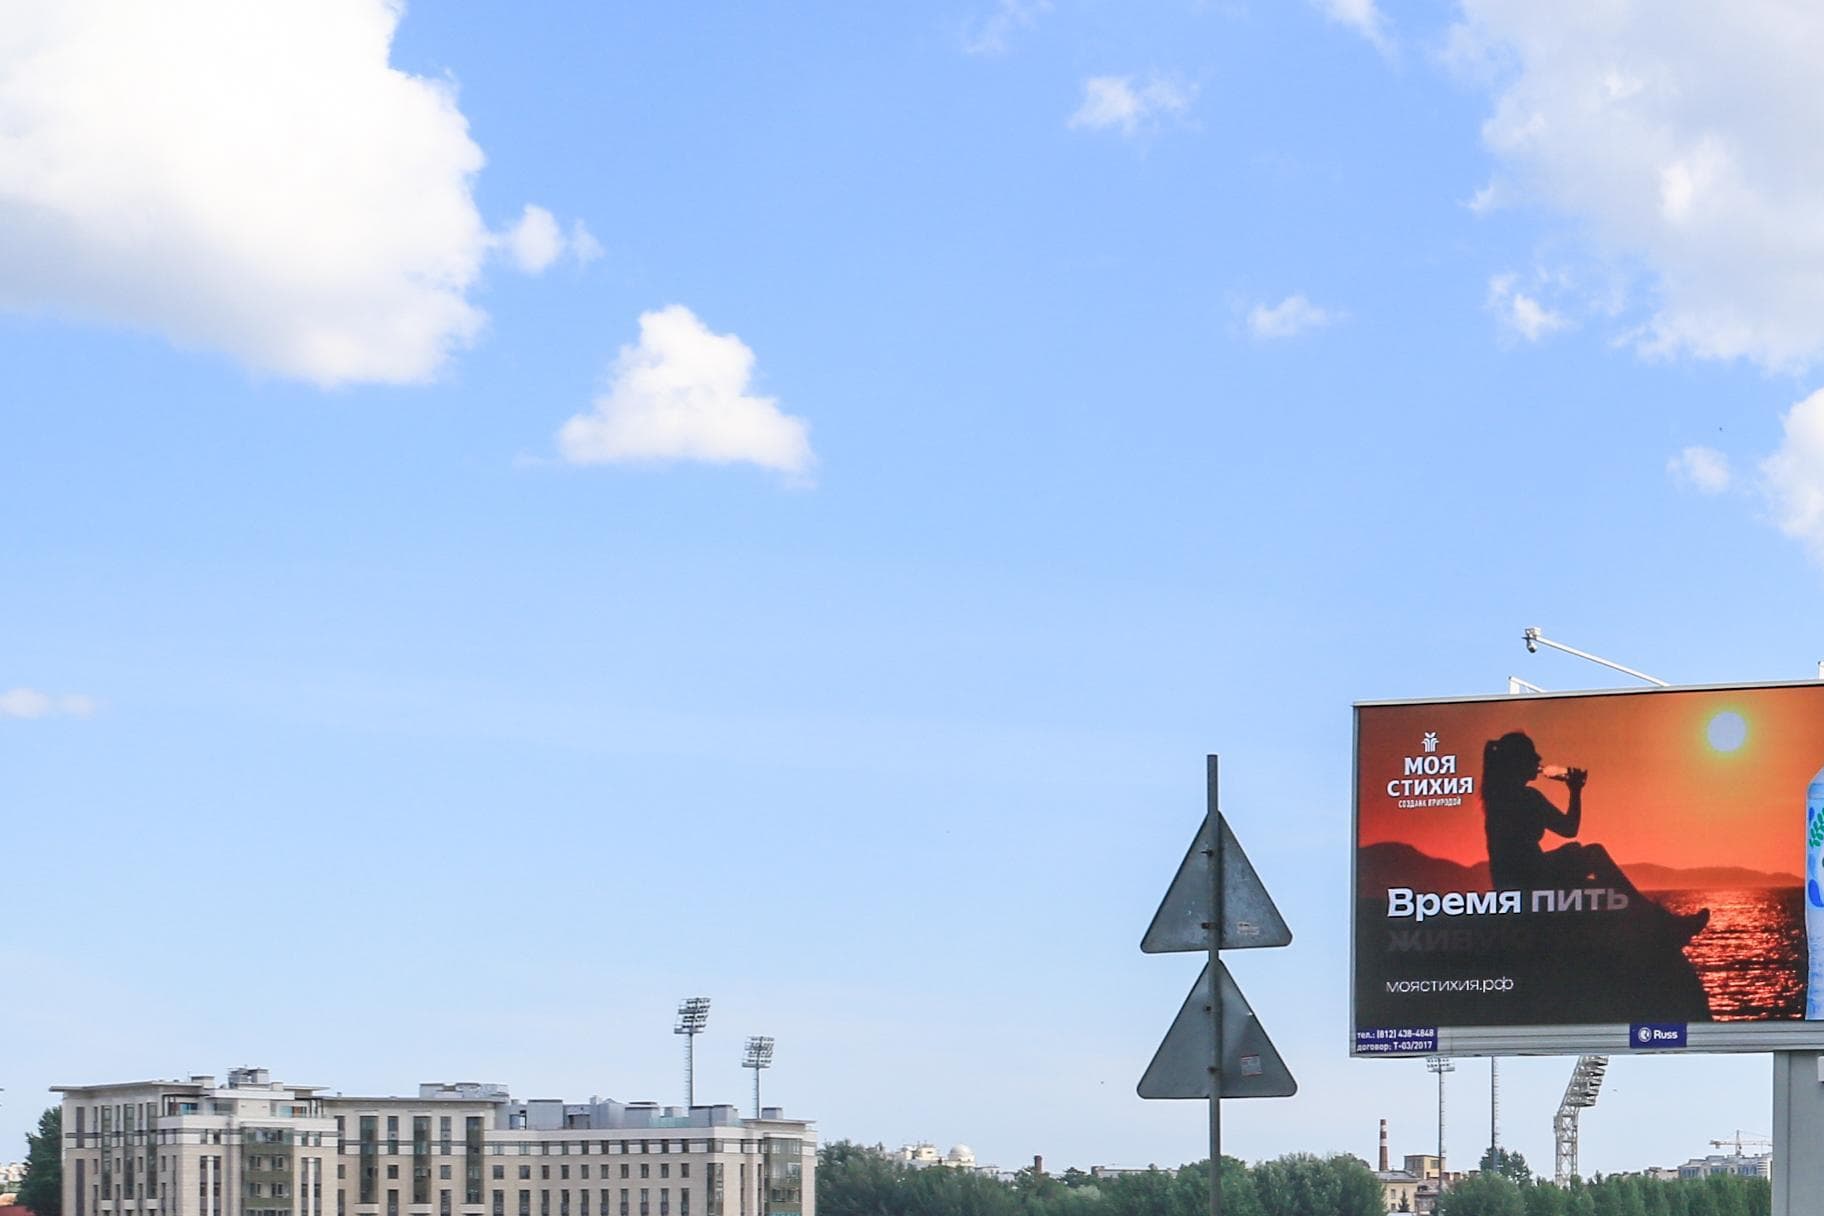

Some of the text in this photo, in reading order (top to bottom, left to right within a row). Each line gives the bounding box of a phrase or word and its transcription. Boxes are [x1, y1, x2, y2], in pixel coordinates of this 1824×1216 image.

[1404, 755, 1456, 775] МОЯ
[1387, 777, 1473, 797] СТИХИЯ
[1387, 888, 1629, 922] Время пить
[1653, 1029, 1678, 1040] Russ
